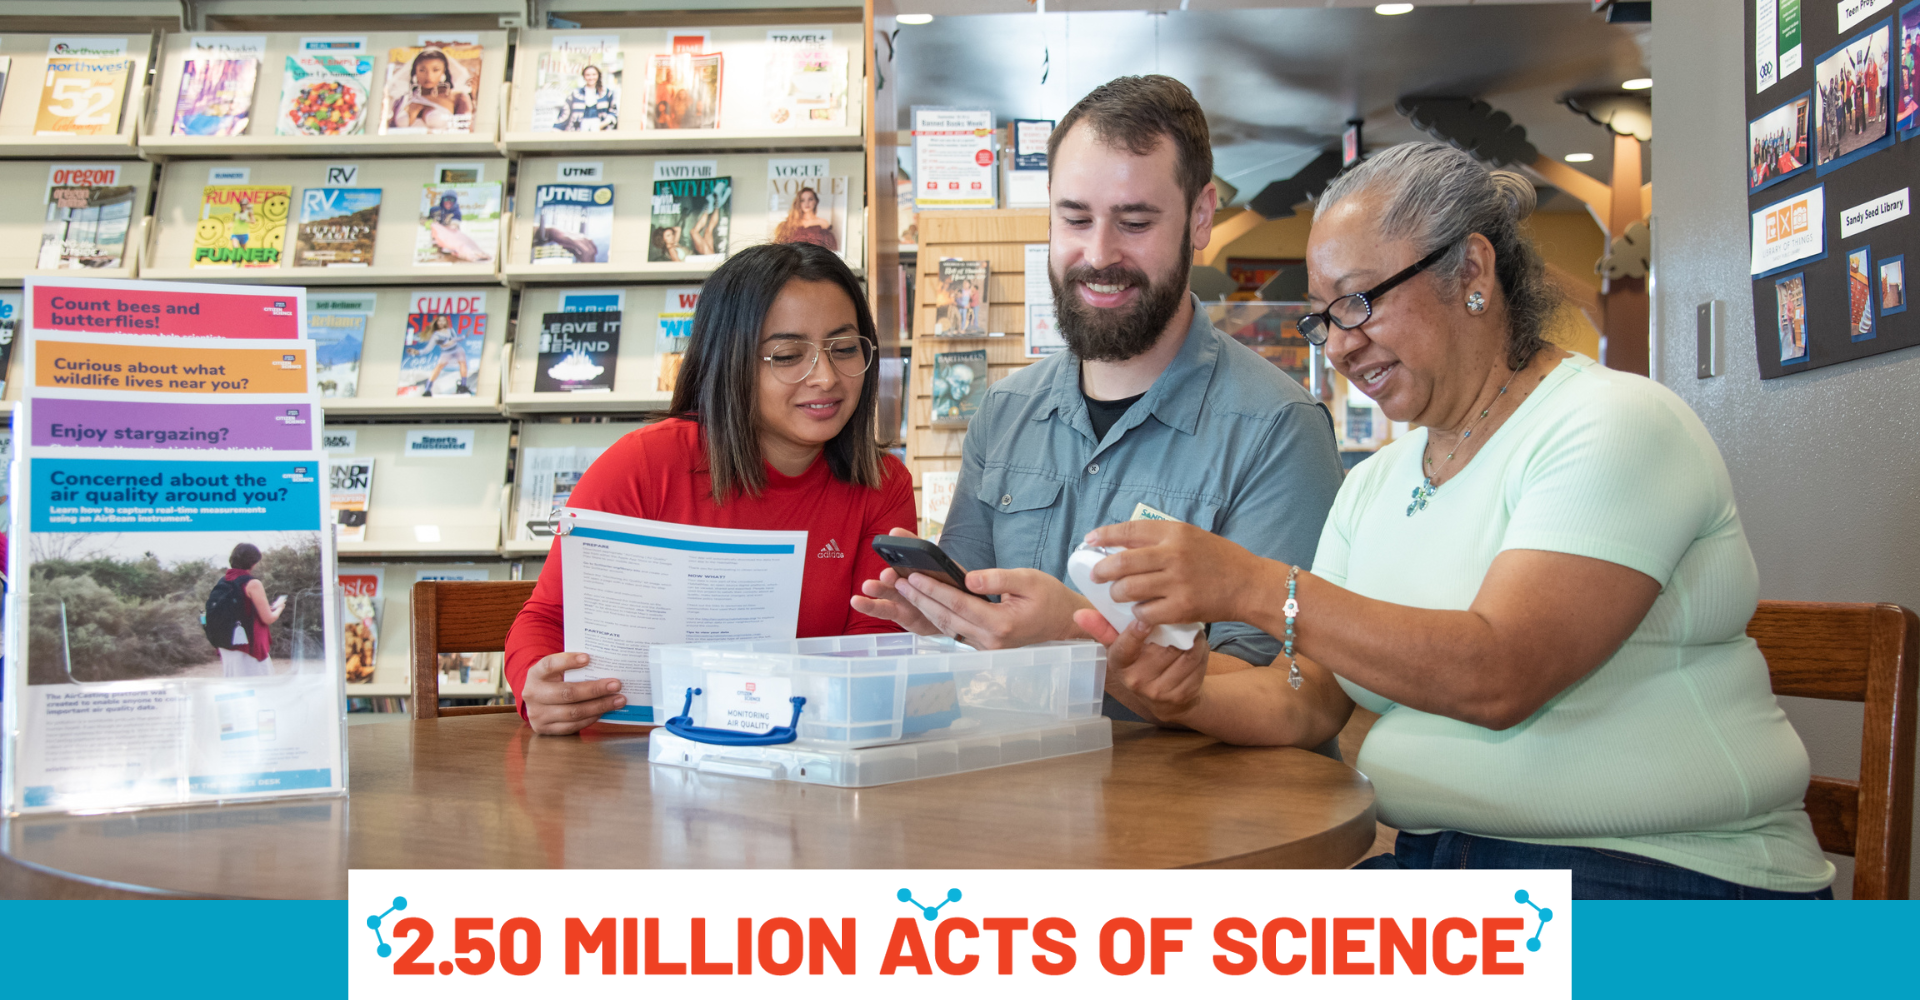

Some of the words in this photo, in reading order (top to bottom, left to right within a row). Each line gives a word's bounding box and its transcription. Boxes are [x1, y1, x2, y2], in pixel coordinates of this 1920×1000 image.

[1845, 6, 1859, 18] Teen
[47, 60, 129, 72] northwest
[48, 78, 115, 125] 52
[53, 169, 115, 186] oregon
[328, 167, 356, 184] RV
[563, 168, 596, 177] UTNE
[660, 166, 689, 176] VANITY
[692, 166, 711, 176] FAIR
[775, 165, 823, 177] VOGUE
[304, 189, 340, 211] RV
[541, 186, 592, 202] UTNE
[1846, 212, 1864, 226] Sandy
[1865, 205, 1879, 220] Seed
[1881, 199, 1904, 214] Library
[195, 247, 279, 262] FUNNER
[51, 296, 111, 312] Count
[117, 299, 161, 314] bees
[166, 302, 200, 315] and
[417, 297, 481, 314] SHAPE
[51, 312, 160, 329] butterflies!
[307, 315, 362, 328] -Reliance
[407, 314, 487, 335] SHPE
[540, 322, 597, 335] LEAVE
[603, 321, 620, 332] IT
[54, 357, 122, 372] Curious
[128, 362, 178, 374] about
[183, 364, 226, 376] what
[53, 373, 120, 387] wildlife
[125, 375, 163, 388] lives
[169, 378, 206, 389] near
[211, 378, 249, 392] you?
[50, 423, 108, 442] Enjoy
[114, 427, 229, 444] stargazing?
[422, 436, 457, 444] Sports
[412, 442, 466, 450] Illustrated
[50, 470, 163, 486] Concerned
[170, 472, 229, 487] about
[234, 472, 267, 487] the
[50, 486, 79, 501] air
[86, 487, 159, 505] quality
[165, 488, 237, 502] around
[243, 487, 289, 505] you?
[49, 506, 79, 514] Learn
[80, 506, 102, 514] how
[104, 506, 115, 514] to
[117, 506, 154, 515] capture
[155, 506, 198, 514] real-time
[200, 506, 267, 514] measurements
[49, 515, 77, 524] using
[94, 514, 136, 523] AirBeam
[137, 514, 193, 523] instrument.
[817, 550, 845, 558] adidas
[340, 579, 375, 595] aste
[584, 628, 620, 638] PARTICIPATE
[727, 709, 770, 720] MONITORING
[740, 720, 770, 730] QUALITY
[258, 778, 281, 786] DESK
